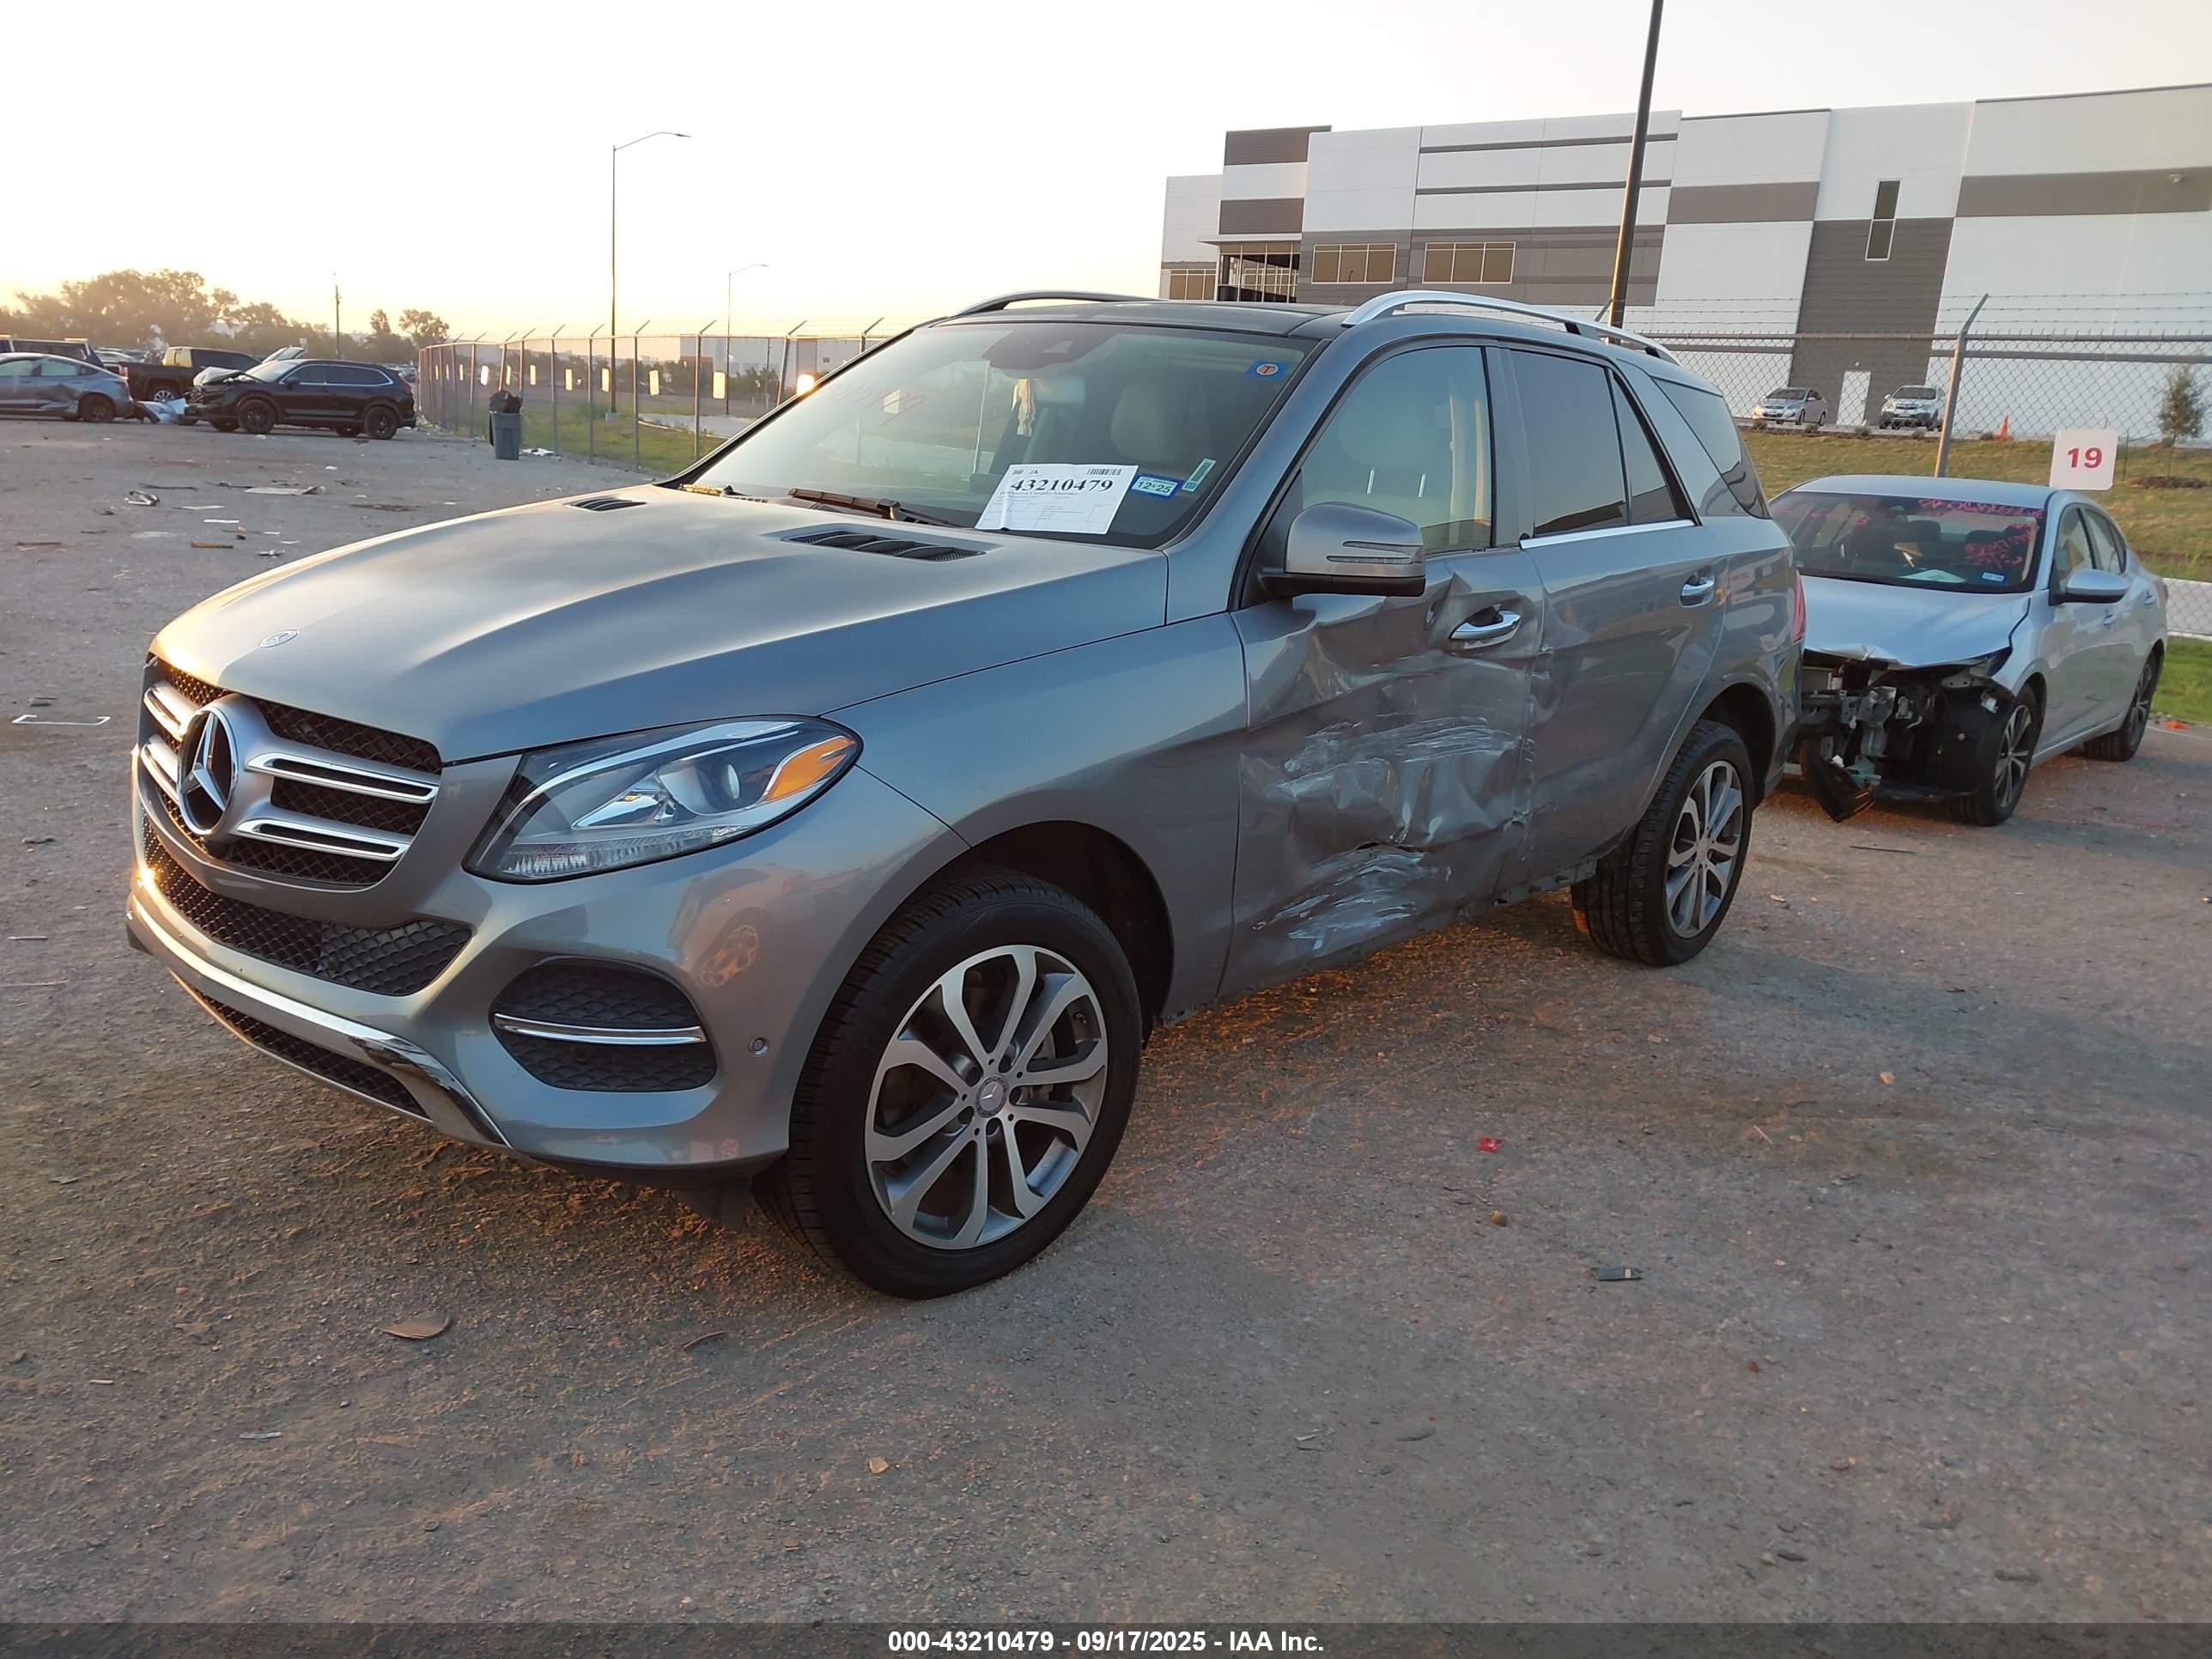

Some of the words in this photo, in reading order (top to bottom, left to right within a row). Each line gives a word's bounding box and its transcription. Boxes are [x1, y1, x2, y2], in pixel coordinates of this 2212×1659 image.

[2067, 447, 2103, 469] 19
[1010, 478, 1114, 492] 43210479
[1155, 483, 1173, 494] 25
